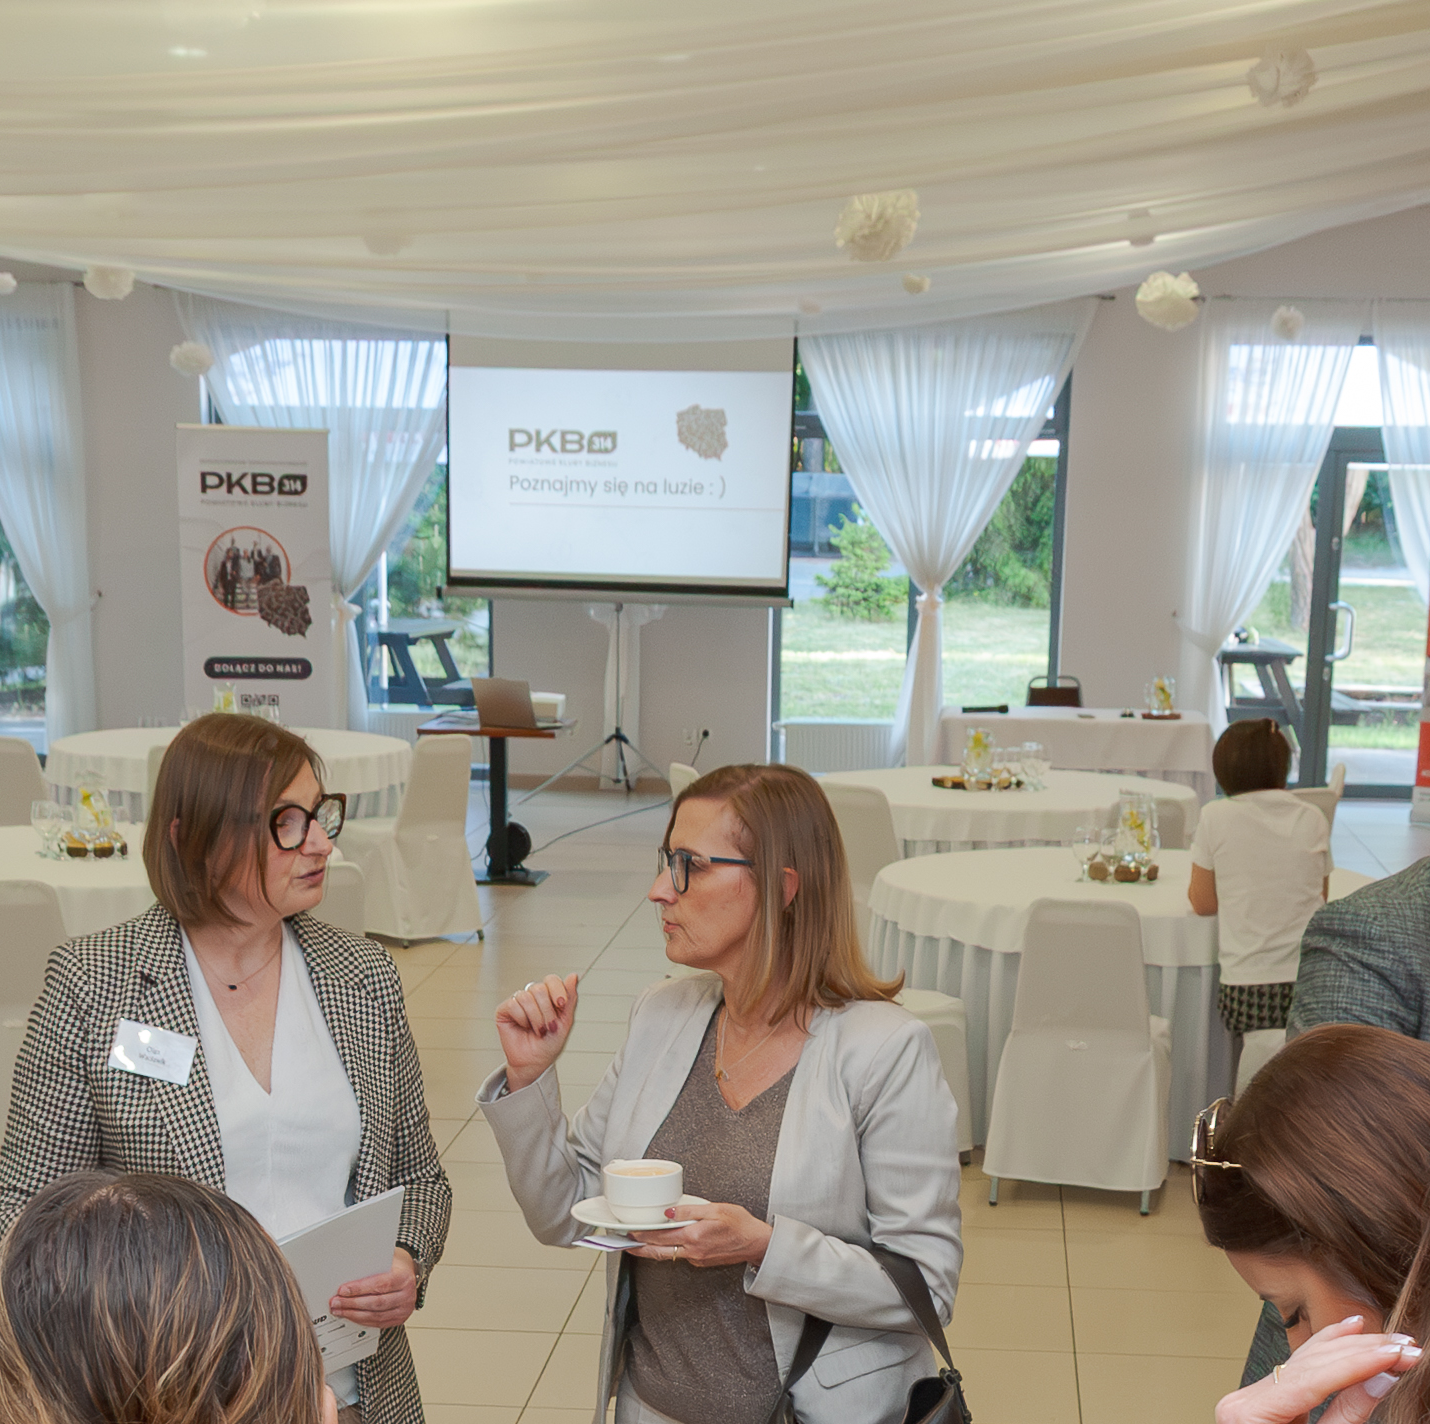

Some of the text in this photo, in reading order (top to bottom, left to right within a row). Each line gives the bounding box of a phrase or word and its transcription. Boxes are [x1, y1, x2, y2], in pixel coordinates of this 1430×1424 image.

[508, 428, 585, 453] PKB
[200, 471, 275, 494] PKB
[509, 475, 598, 497] Poznajmy
[603, 477, 629, 497] się
[633, 480, 658, 495] na
[662, 478, 705, 495] luzie
[257, 663, 275, 674] DO
